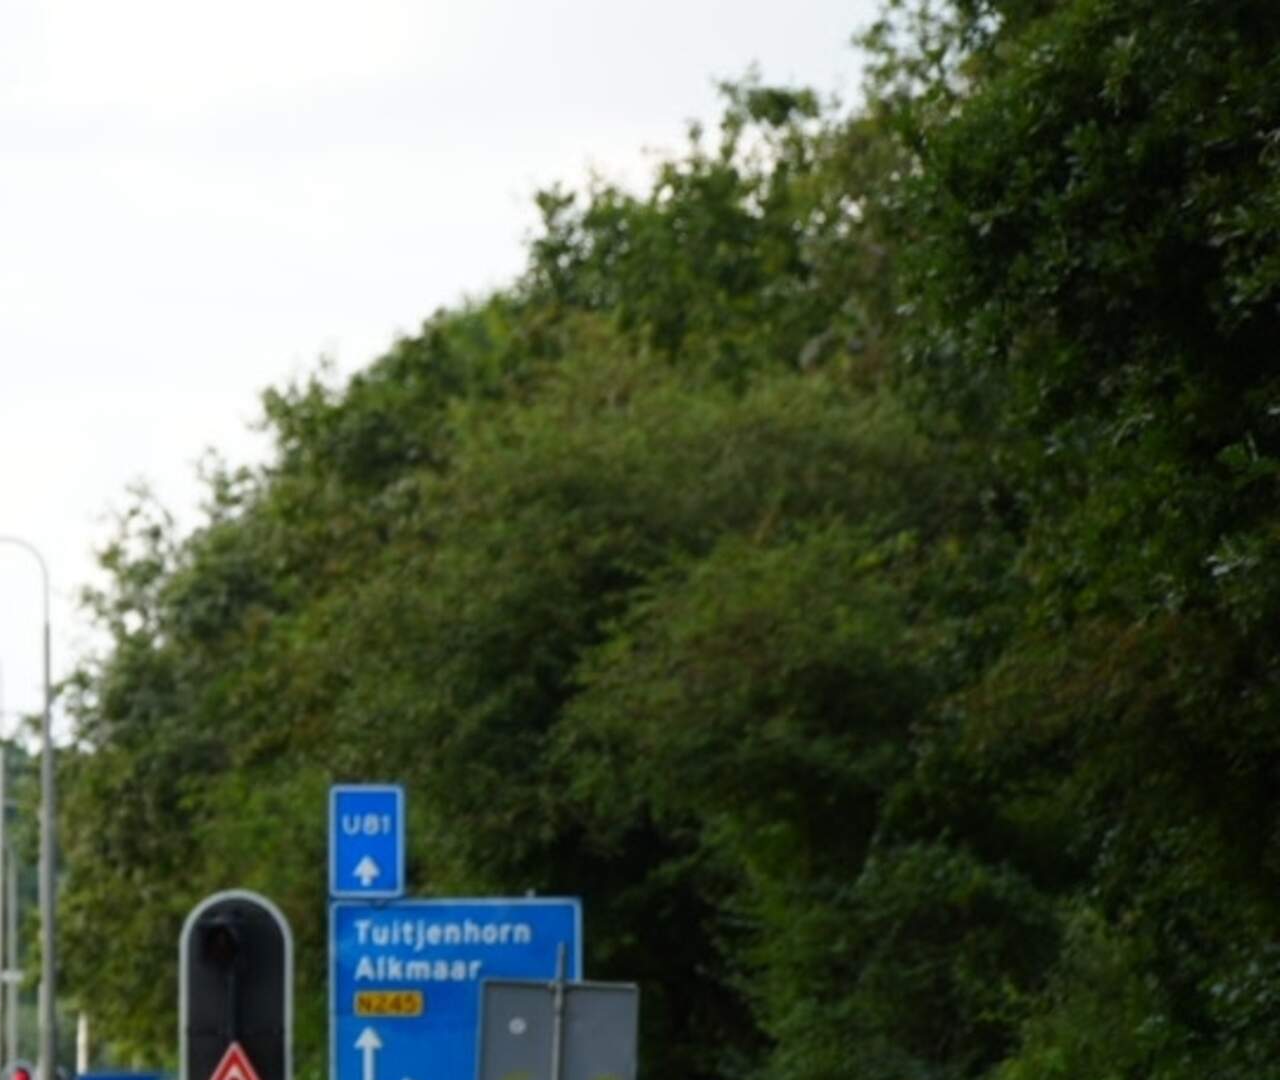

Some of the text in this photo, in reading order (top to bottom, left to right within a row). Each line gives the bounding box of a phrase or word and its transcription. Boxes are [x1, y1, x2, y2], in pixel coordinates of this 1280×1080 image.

[342, 814, 391, 836] U81
[354, 918, 532, 952] Tuitjenhorn
[354, 955, 482, 982] Alkmaar
[357, 993, 419, 1014] N245
